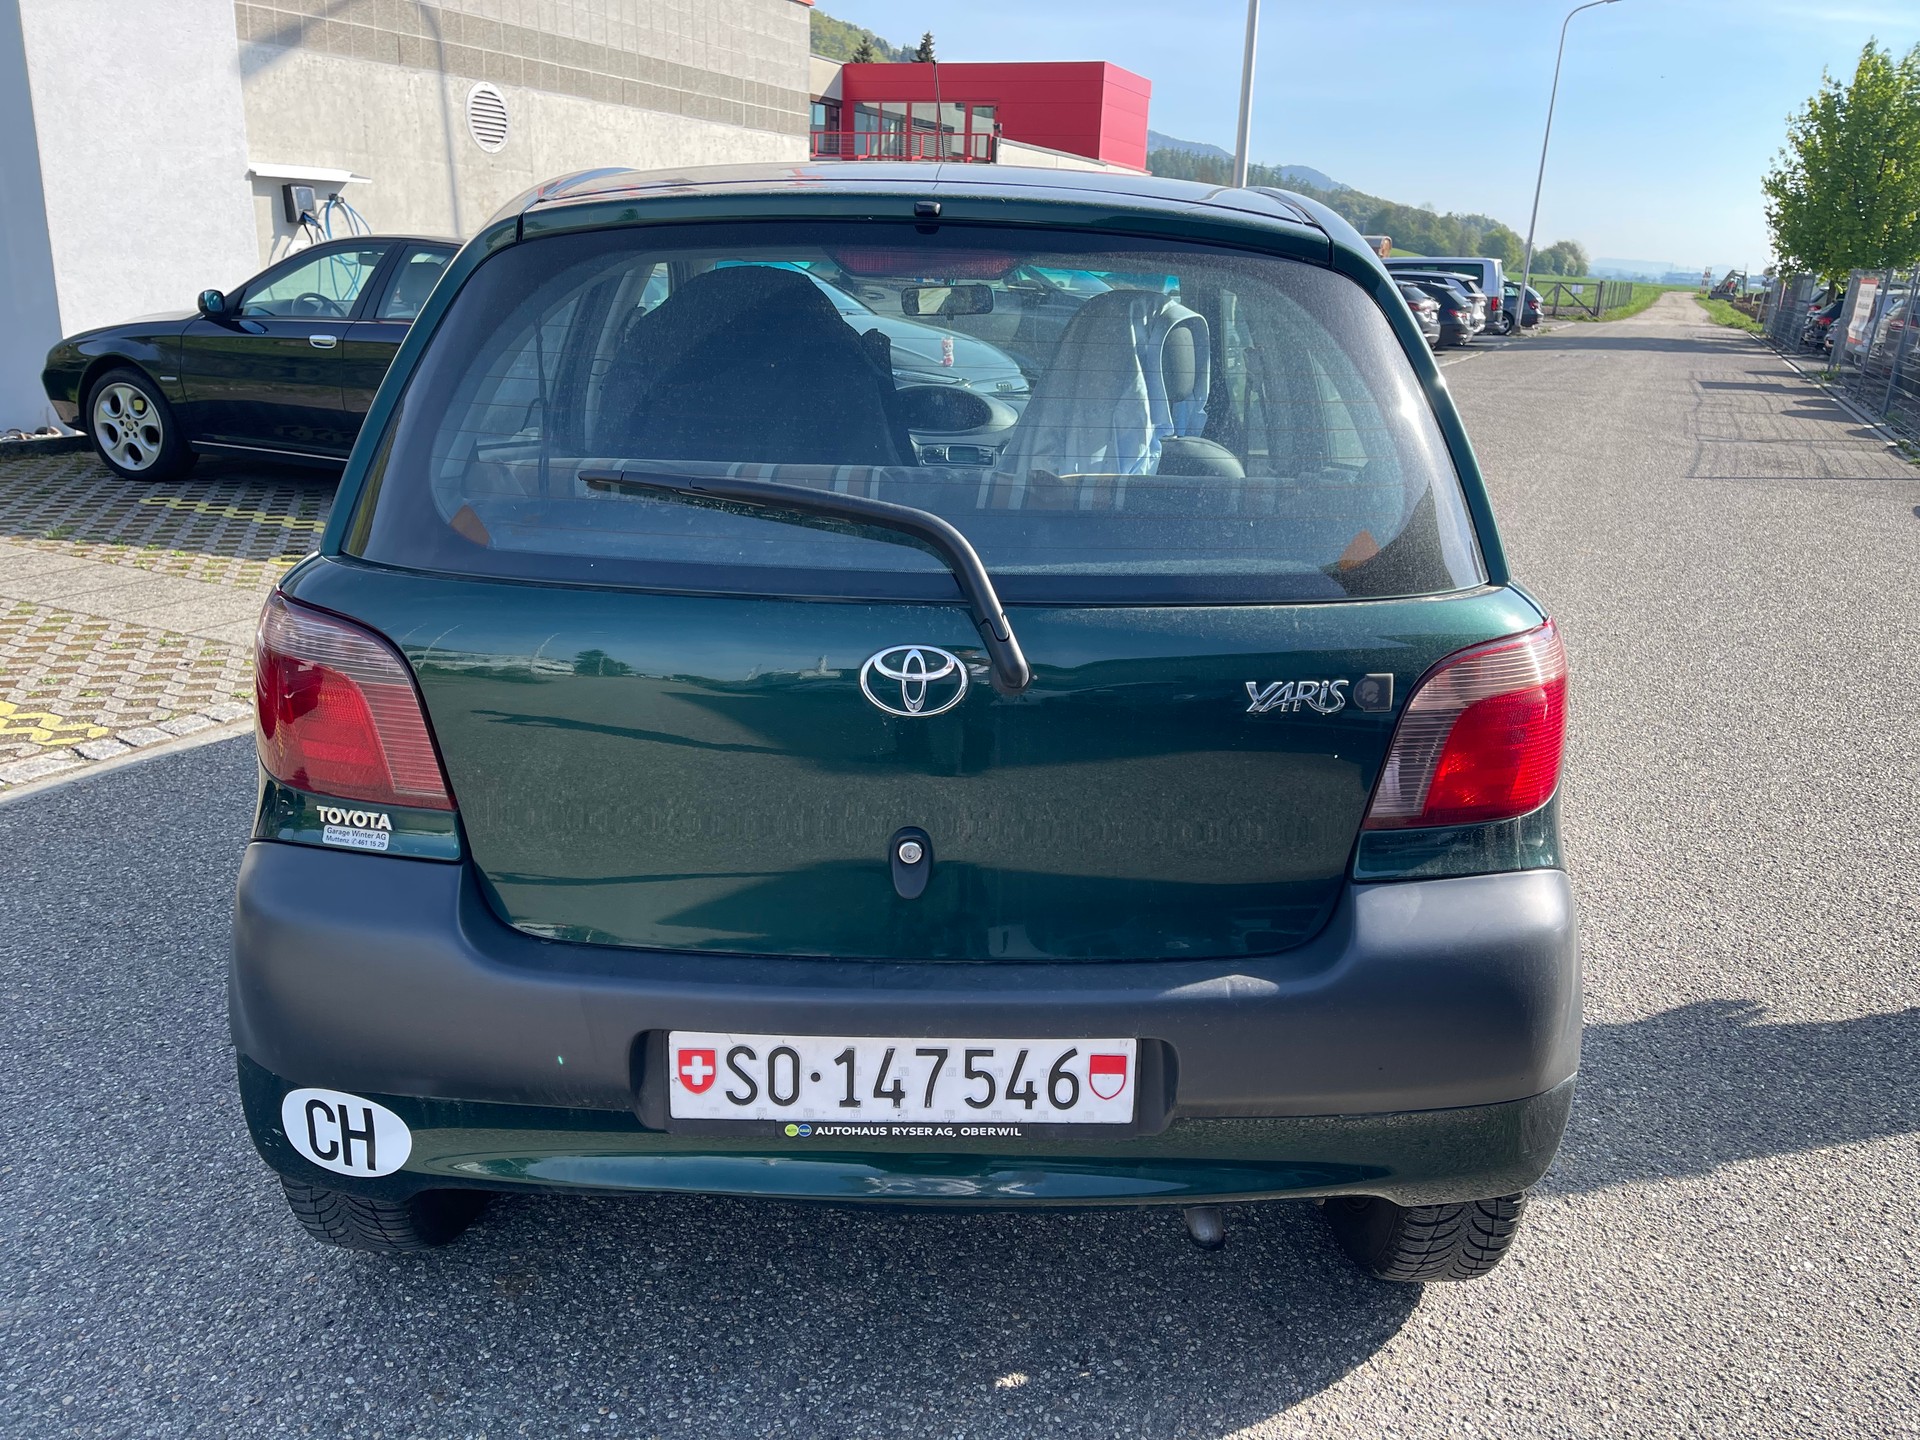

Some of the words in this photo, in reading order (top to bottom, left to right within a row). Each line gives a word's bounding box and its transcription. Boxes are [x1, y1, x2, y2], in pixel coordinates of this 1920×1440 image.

[316, 805, 393, 831] TOYOTA
[326, 827, 350, 837] Garage
[352, 830, 374, 839] Winter
[305, 1099, 376, 1171] CH
[815, 1126, 887, 1137] AUTOHAUS
[892, 1127, 934, 1136] RYSER
[935, 1127, 957, 1138] AG,
[960, 1127, 1022, 1137] OBERWIL
